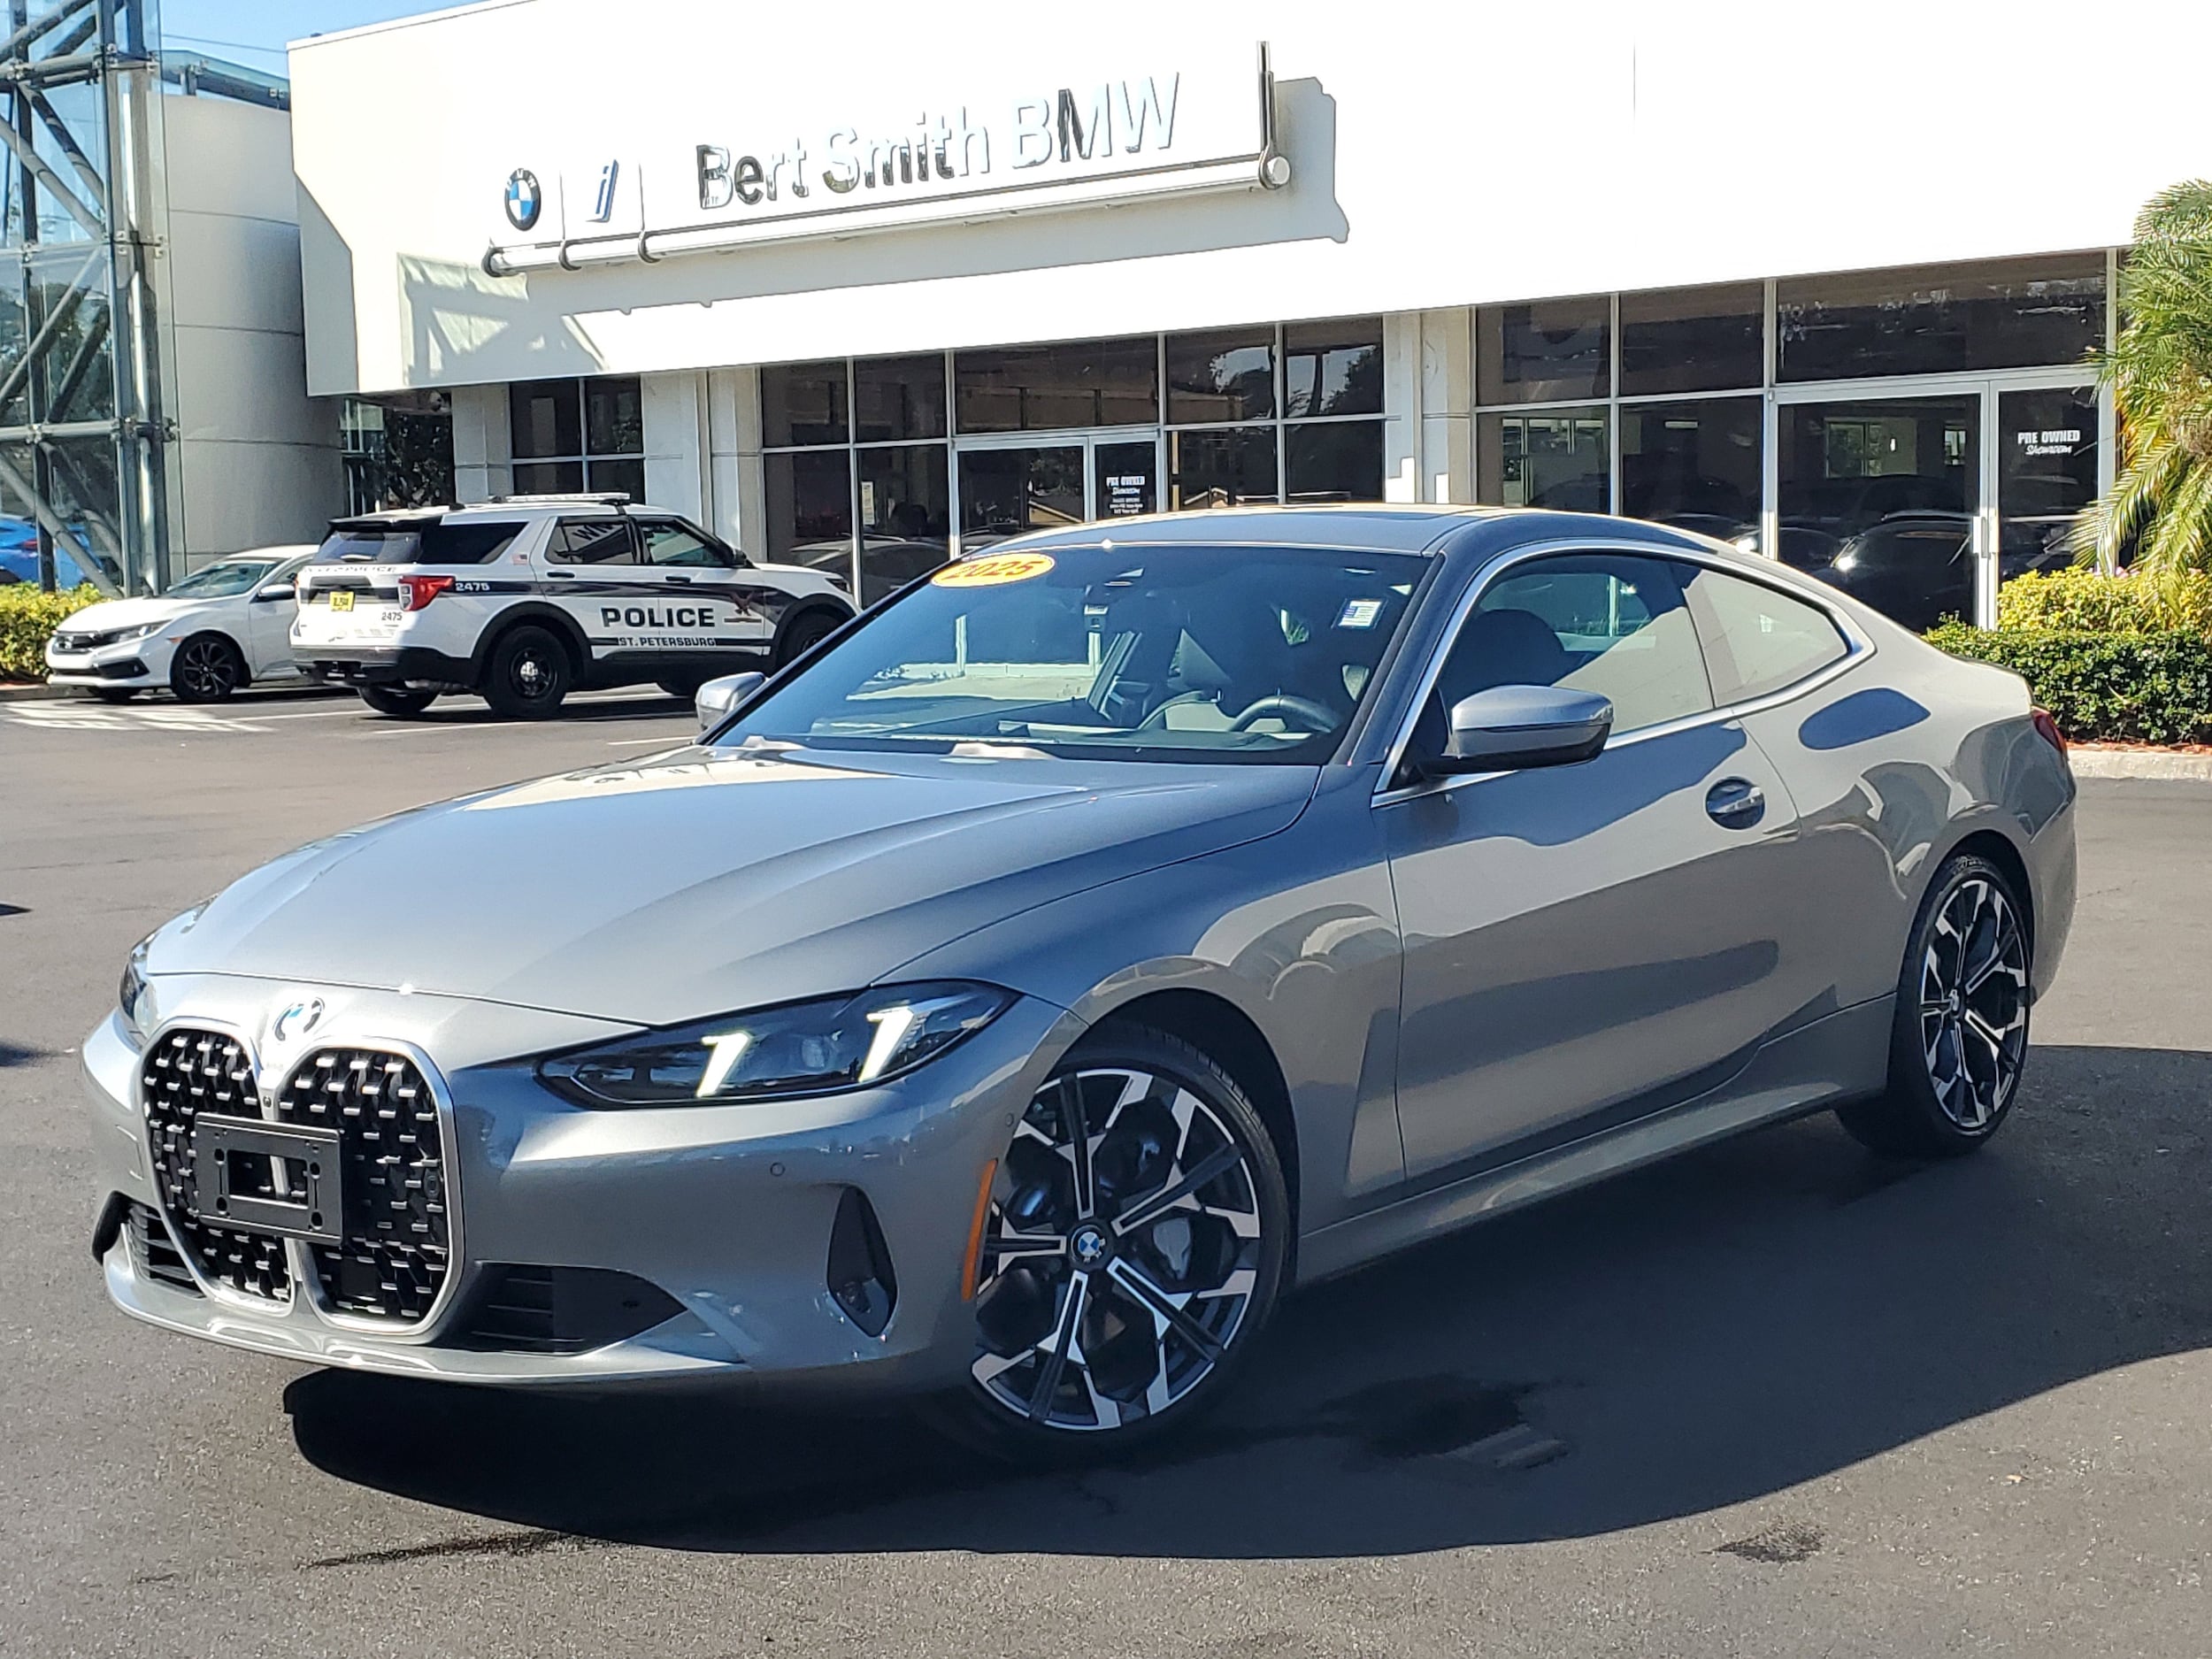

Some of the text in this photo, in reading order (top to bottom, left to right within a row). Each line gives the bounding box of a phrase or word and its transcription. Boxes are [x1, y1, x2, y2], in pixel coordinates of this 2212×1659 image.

[696, 71, 1179, 210] Bert Smith BMW
[2017, 430, 2080, 444] PRE OWNED
[941, 561, 1044, 580] 2025
[455, 582, 490, 591] 2475
[381, 612, 403, 621] 2475
[601, 607, 716, 627] POLICE
[618, 636, 716, 647] ST. PETERSBURG
